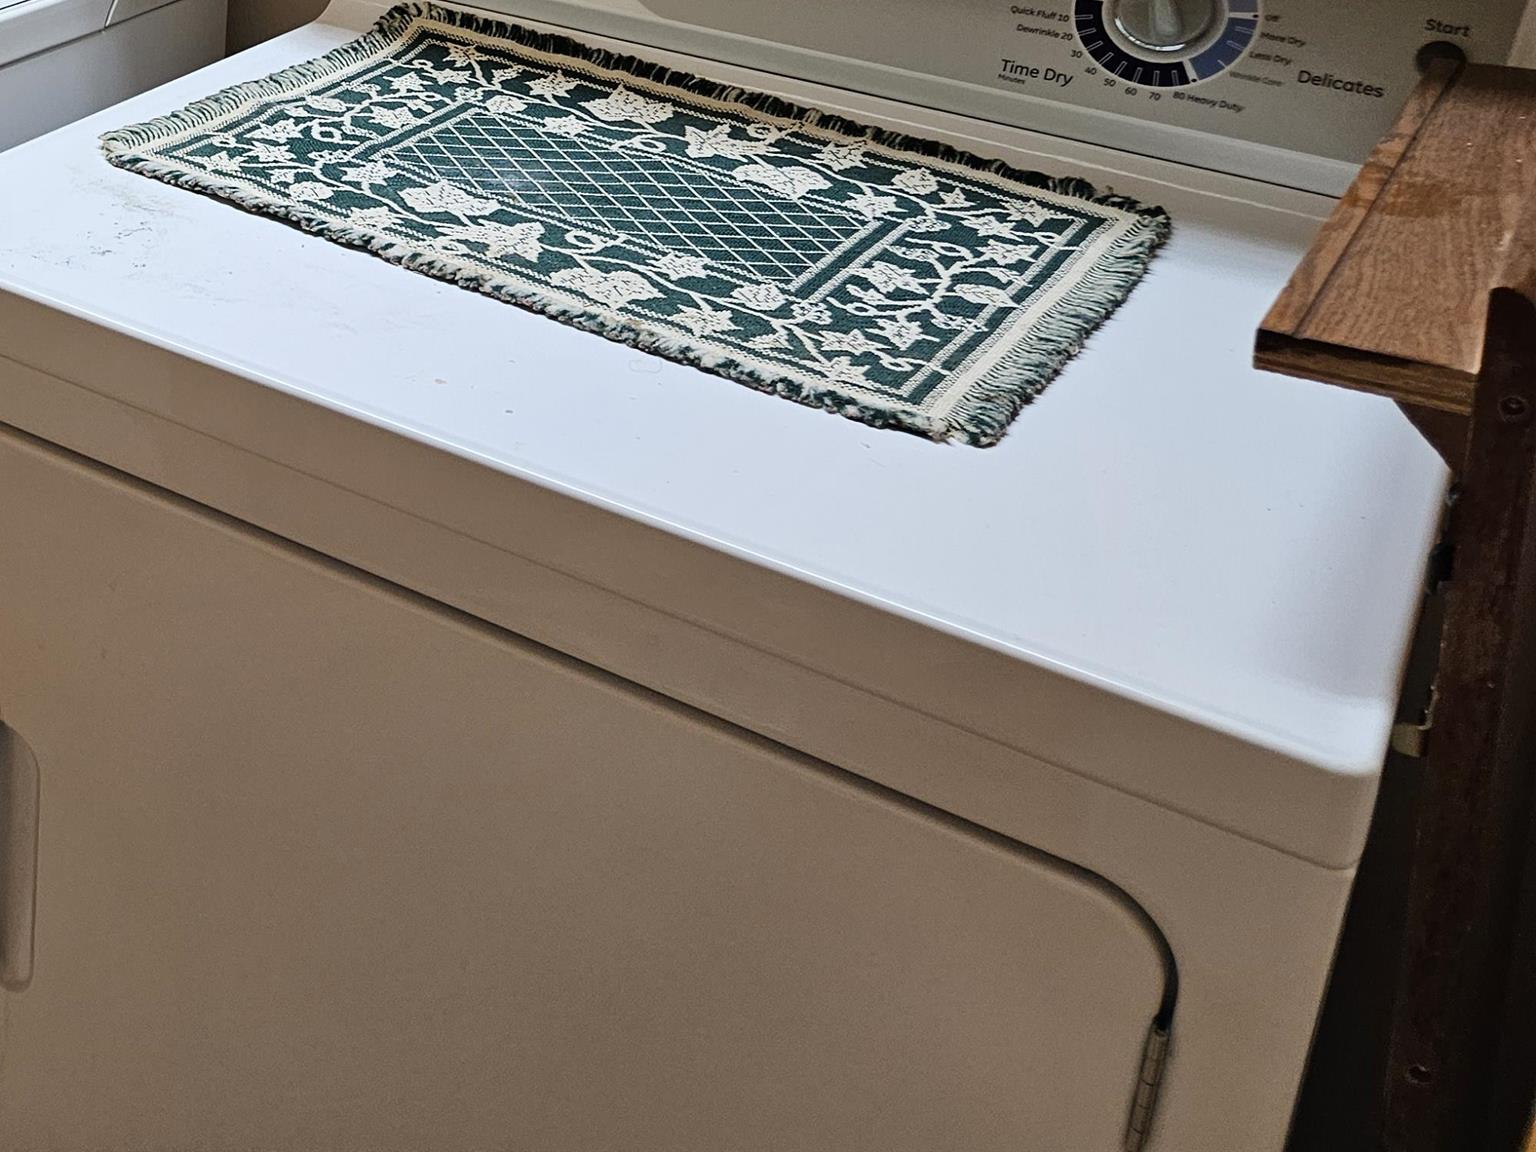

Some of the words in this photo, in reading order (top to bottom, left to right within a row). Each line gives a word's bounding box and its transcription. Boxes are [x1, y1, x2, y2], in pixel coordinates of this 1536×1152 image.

[1010, 5, 1035, 17] Quick
[1035, 8, 1058, 20] Fluff
[1057, 13, 1070, 23] 10
[1016, 23, 1060, 39] Dewrinkle
[1060, 32, 1074, 41] 20
[1424, 17, 1471, 38] Start
[1287, 35, 1306, 47] Dry
[1070, 49, 1084, 59] 30
[1249, 50, 1273, 61] Less
[1273, 53, 1293, 66] Dry
[1001, 58, 1040, 79] Time
[1043, 67, 1074, 88] Dry
[1084, 66, 1098, 76] 40
[1103, 77, 1117, 87] 50
[1297, 69, 1385, 99] Delicates
[1124, 86, 1138, 96] 60
[1148, 91, 1162, 101] 70
[1172, 91, 1186, 100] 80
[1186, 93, 1218, 109] Heavy
[1218, 99, 1247, 113] Duty
